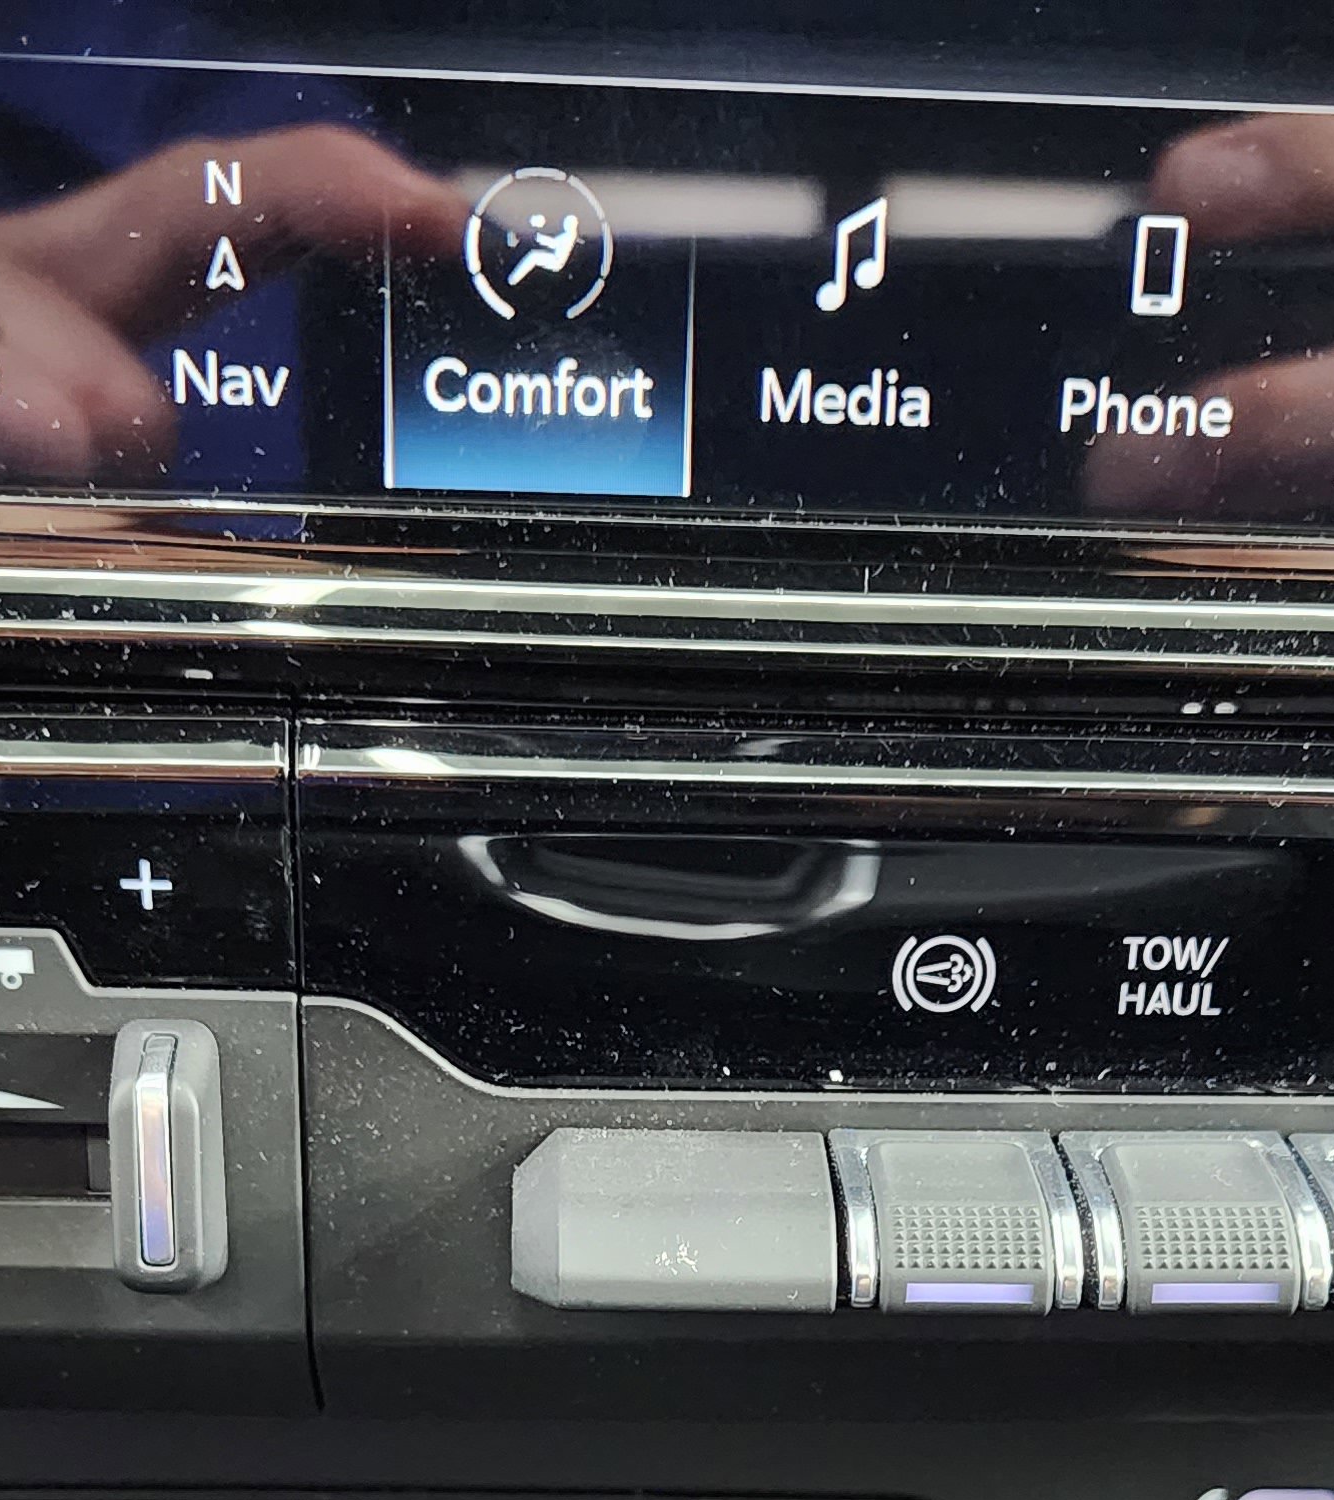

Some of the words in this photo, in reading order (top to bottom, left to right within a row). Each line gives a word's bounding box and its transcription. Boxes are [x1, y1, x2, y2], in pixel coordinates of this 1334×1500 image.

[206, 160, 242, 205] N
[173, 349, 290, 407] Nav
[424, 356, 654, 420] Comfort
[760, 367, 931, 429] Media
[1060, 376, 1234, 439] Phone
[1122, 935, 1229, 974] TOW/
[1117, 981, 1222, 1017] HAUL
